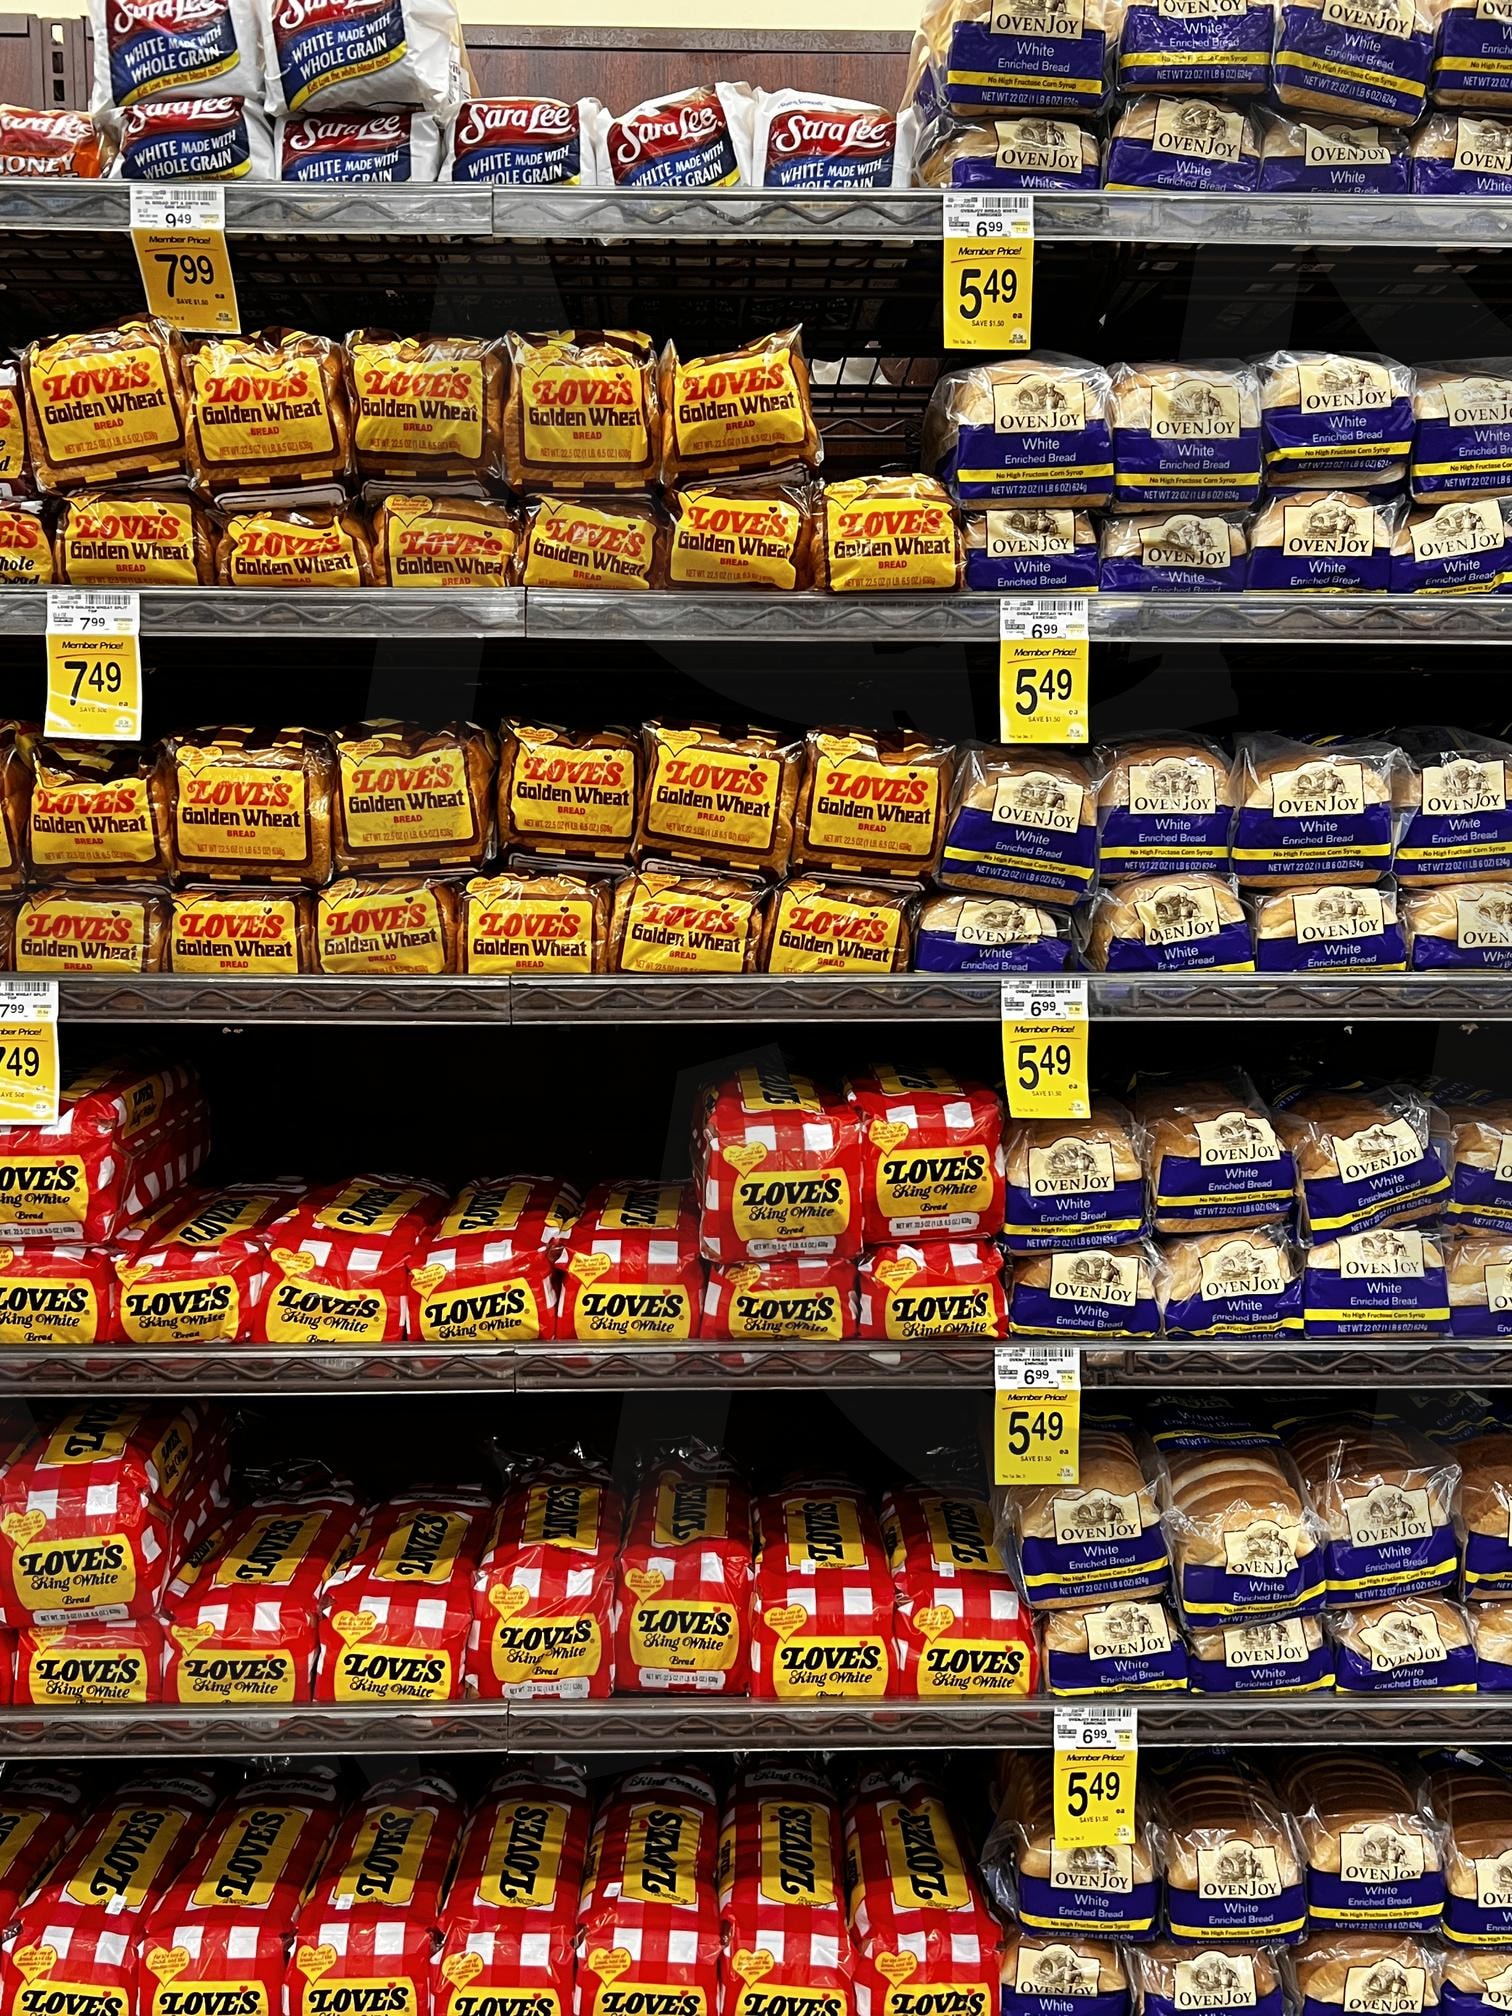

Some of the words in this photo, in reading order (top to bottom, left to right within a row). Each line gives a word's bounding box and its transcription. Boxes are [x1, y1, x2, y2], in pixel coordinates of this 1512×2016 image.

[292, 32, 335, 65] WHITE
[337, 24, 365, 43] MADE
[366, 14, 391, 35] WITH
[1345, 33, 1381, 51] White
[1016, 41, 1054, 56] White
[300, 50, 344, 82] WHOLE
[344, 32, 388, 61] GRAIN
[998, 58, 1040, 70] Enriched
[1042, 61, 1070, 73] Bread
[459, 103, 526, 144] Sara
[525, 102, 576, 135] Lee
[776, 114, 846, 152] Sara
[844, 118, 891, 147] Lee
[134, 140, 177, 168] WHITE
[181, 136, 209, 154] MADE
[210, 130, 236, 148] WITH
[468, 150, 512, 179] WHITE
[515, 150, 542, 167] MADE
[543, 146, 570, 163] WITH
[958, 247, 996, 256] Member
[997, 247, 1022, 255] Price!
[154, 254, 214, 298] 799
[960, 269, 1017, 319] 549
[45, 396, 105, 425] Golden
[107, 389, 166, 414] Wheat
[679, 400, 739, 424] Golden
[740, 392, 796, 416] Wheat
[94, 418, 124, 431] BREAD
[529, 408, 586, 426] Golden
[589, 408, 642, 426] Wheat
[1330, 415, 1367, 428] White
[726, 420, 756, 432] BREAD
[573, 431, 602, 440] BREAD
[1312, 431, 1353, 443] Enriched
[1356, 430, 1383, 440] Bread
[1022, 438, 1060, 450] White
[1005, 454, 1046, 464] Enriched
[1048, 453, 1076, 463] Bread
[991, 486, 1004, 495] NET
[1006, 486, 1017, 494] WT
[1028, 485, 1037, 493] OZ
[1045, 485, 1053, 493] LB
[71, 542, 129, 559] Golden
[131, 542, 189, 560] Wheat
[1309, 561, 1346, 573] White
[64, 661, 121, 706] 749
[1016, 668, 1072, 715] 549
[349, 796, 407, 814] Golden
[408, 791, 465, 810] Wheat
[656, 786, 714, 810] Golden
[715, 794, 771, 818] Wheat
[393, 815, 423, 824] BREAD
[697, 812, 725, 823] BREAD
[1300, 821, 1338, 832] White
[1282, 836, 1323, 845] Enriched
[1326, 835, 1354, 843] Bread
[1019, 1045, 1071, 1090] 549
[1224, 1168, 1258, 1178] White
[892, 1184, 931, 1199] King
[933, 1183, 977, 1195] White
[1208, 1181, 1246, 1192] Enriched
[1248, 1180, 1272, 1189] Bread
[749, 1205, 788, 1222] King
[790, 1206, 835, 1217] White
[920, 1203, 947, 1211] Bread
[139, 1314, 178, 1329] King
[180, 1313, 225, 1326] White
[1008, 1412, 1063, 1455] 549
[1083, 1544, 1119, 1557] White
[644, 1634, 680, 1652] King
[682, 1636, 724, 1650] White
[669, 1656, 696, 1666] Bread
[932, 1672, 969, 1689] King
[973, 1675, 1014, 1689] White
[1068, 1772, 1120, 1816] 549
[1224, 1903, 1259, 1913] White
[1348, 1898, 1385, 1906] Enriched
[1387, 1897, 1412, 1905] Bread
